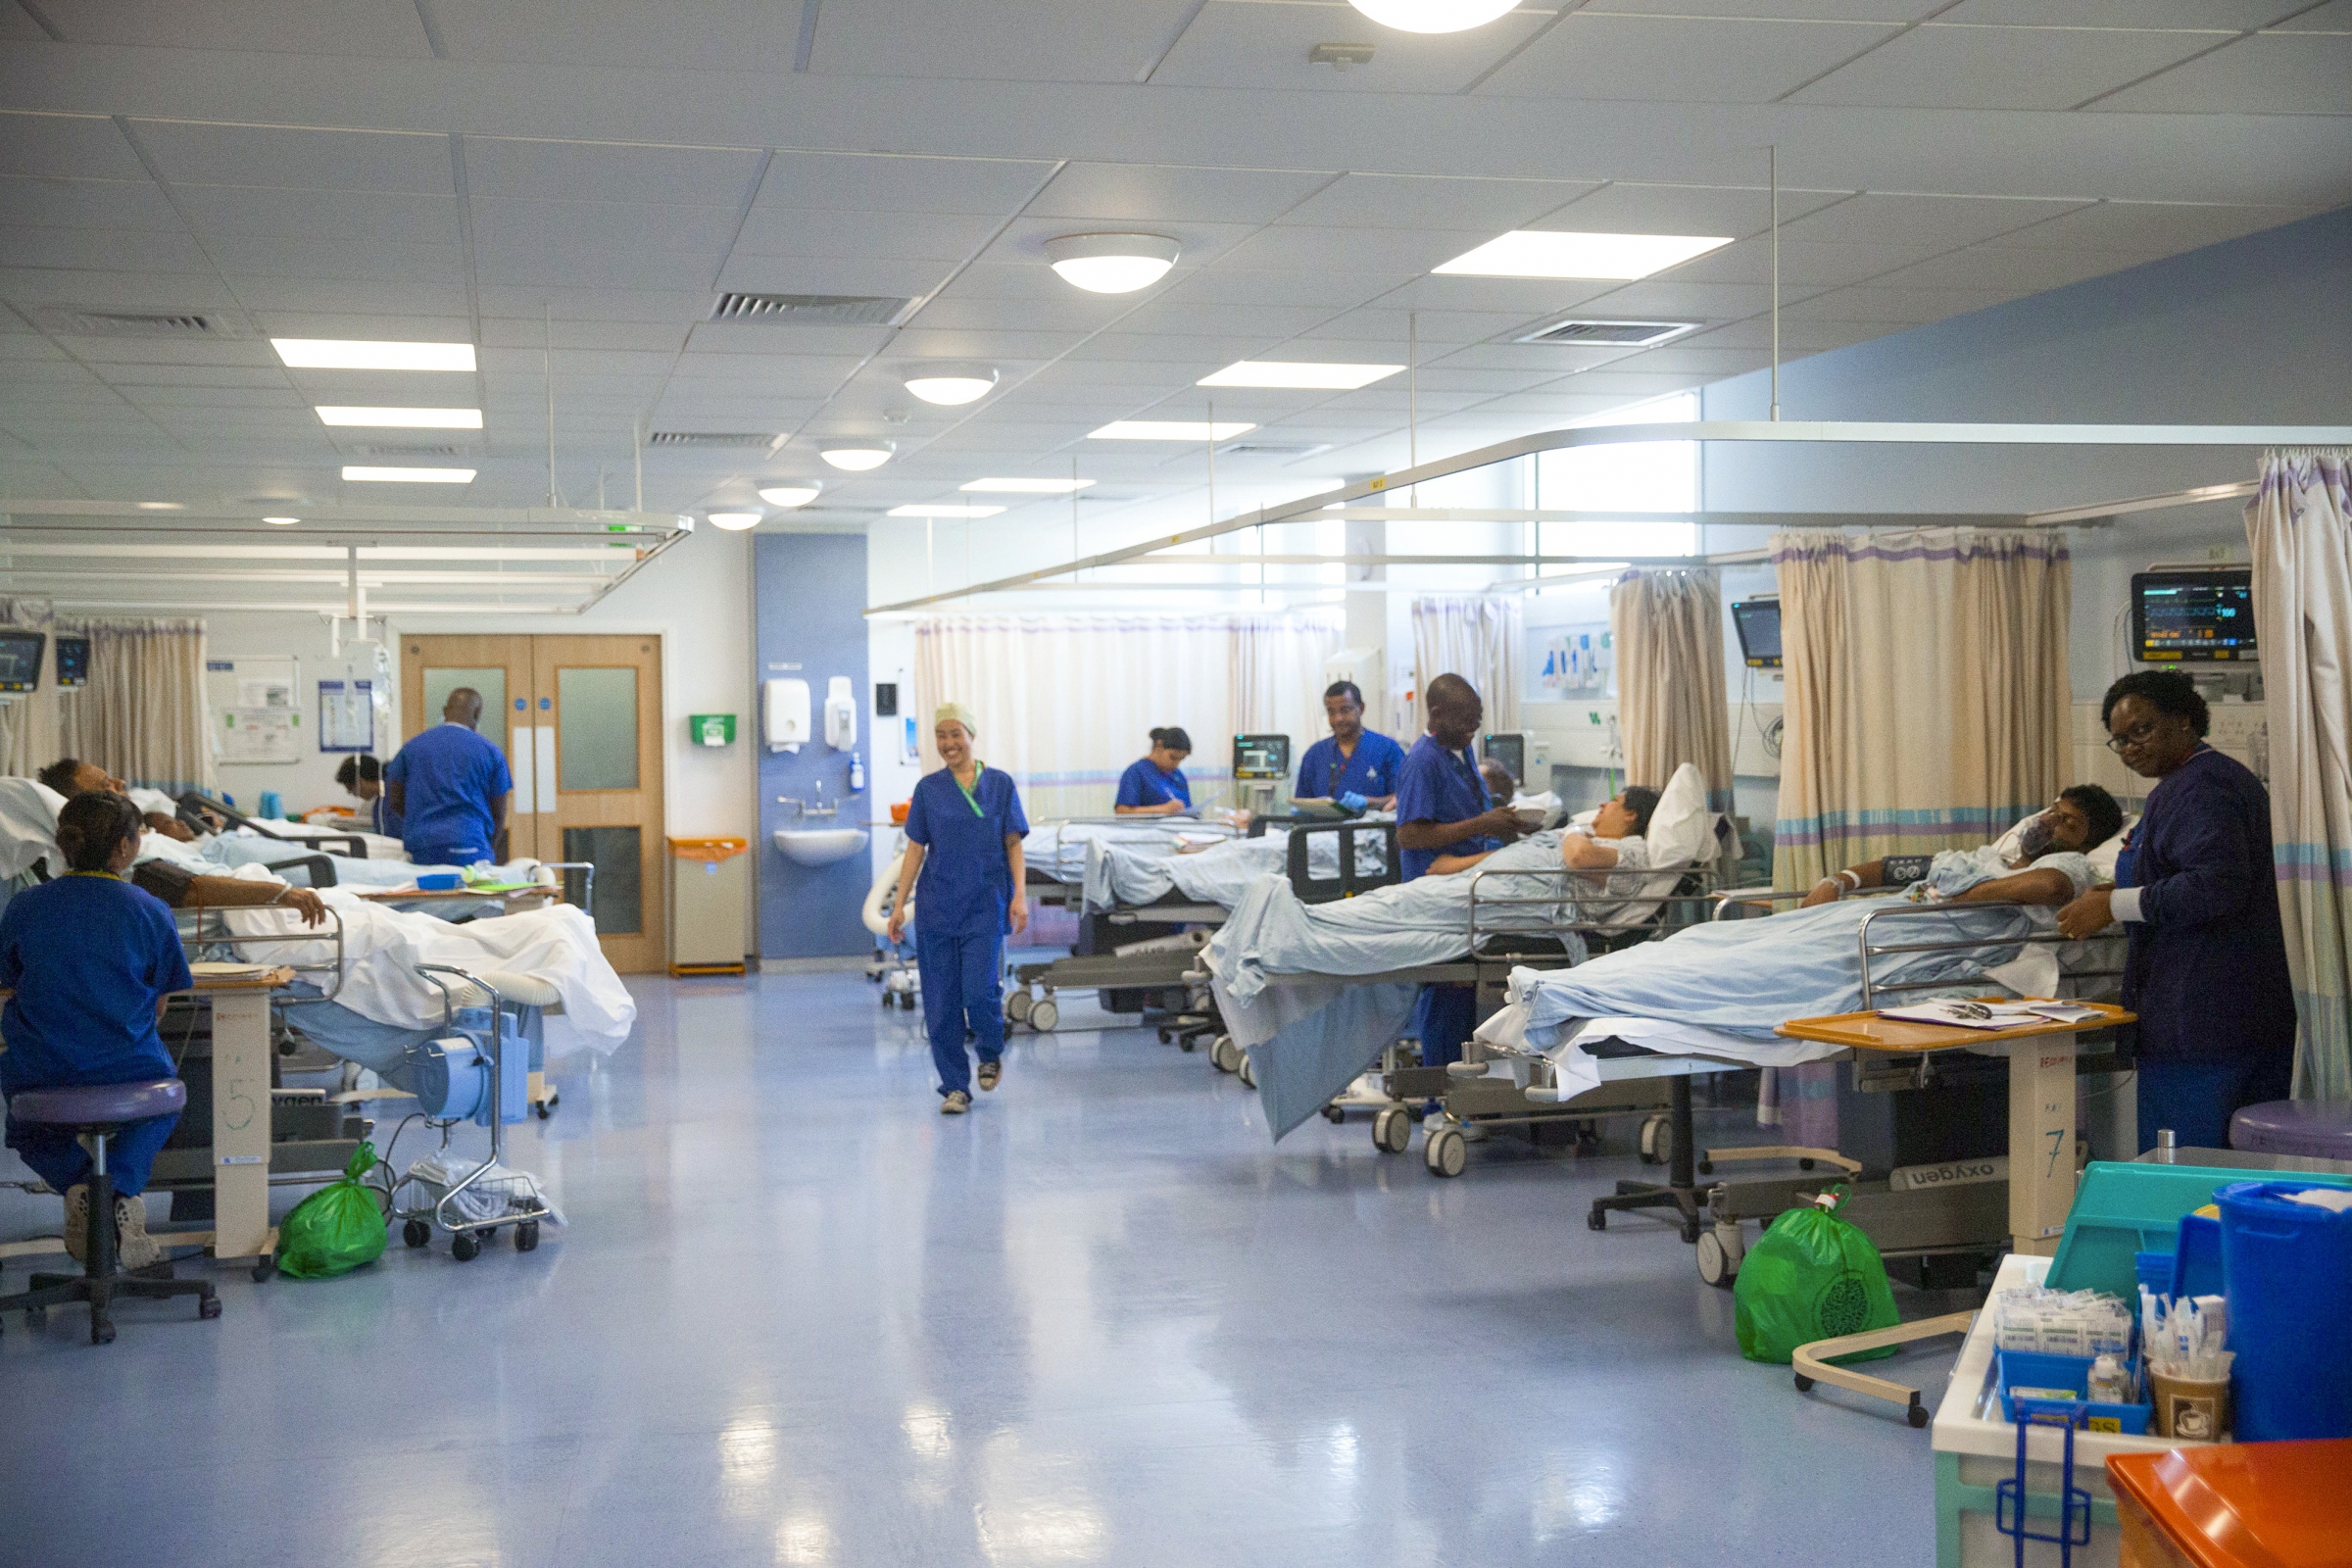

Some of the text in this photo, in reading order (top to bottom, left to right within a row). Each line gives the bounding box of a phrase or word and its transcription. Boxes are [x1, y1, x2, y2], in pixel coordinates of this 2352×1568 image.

[222, 1078, 255, 1131] 5
[1912, 1164, 1994, 1185] oxygen
[2045, 1129, 2065, 1178] 7
